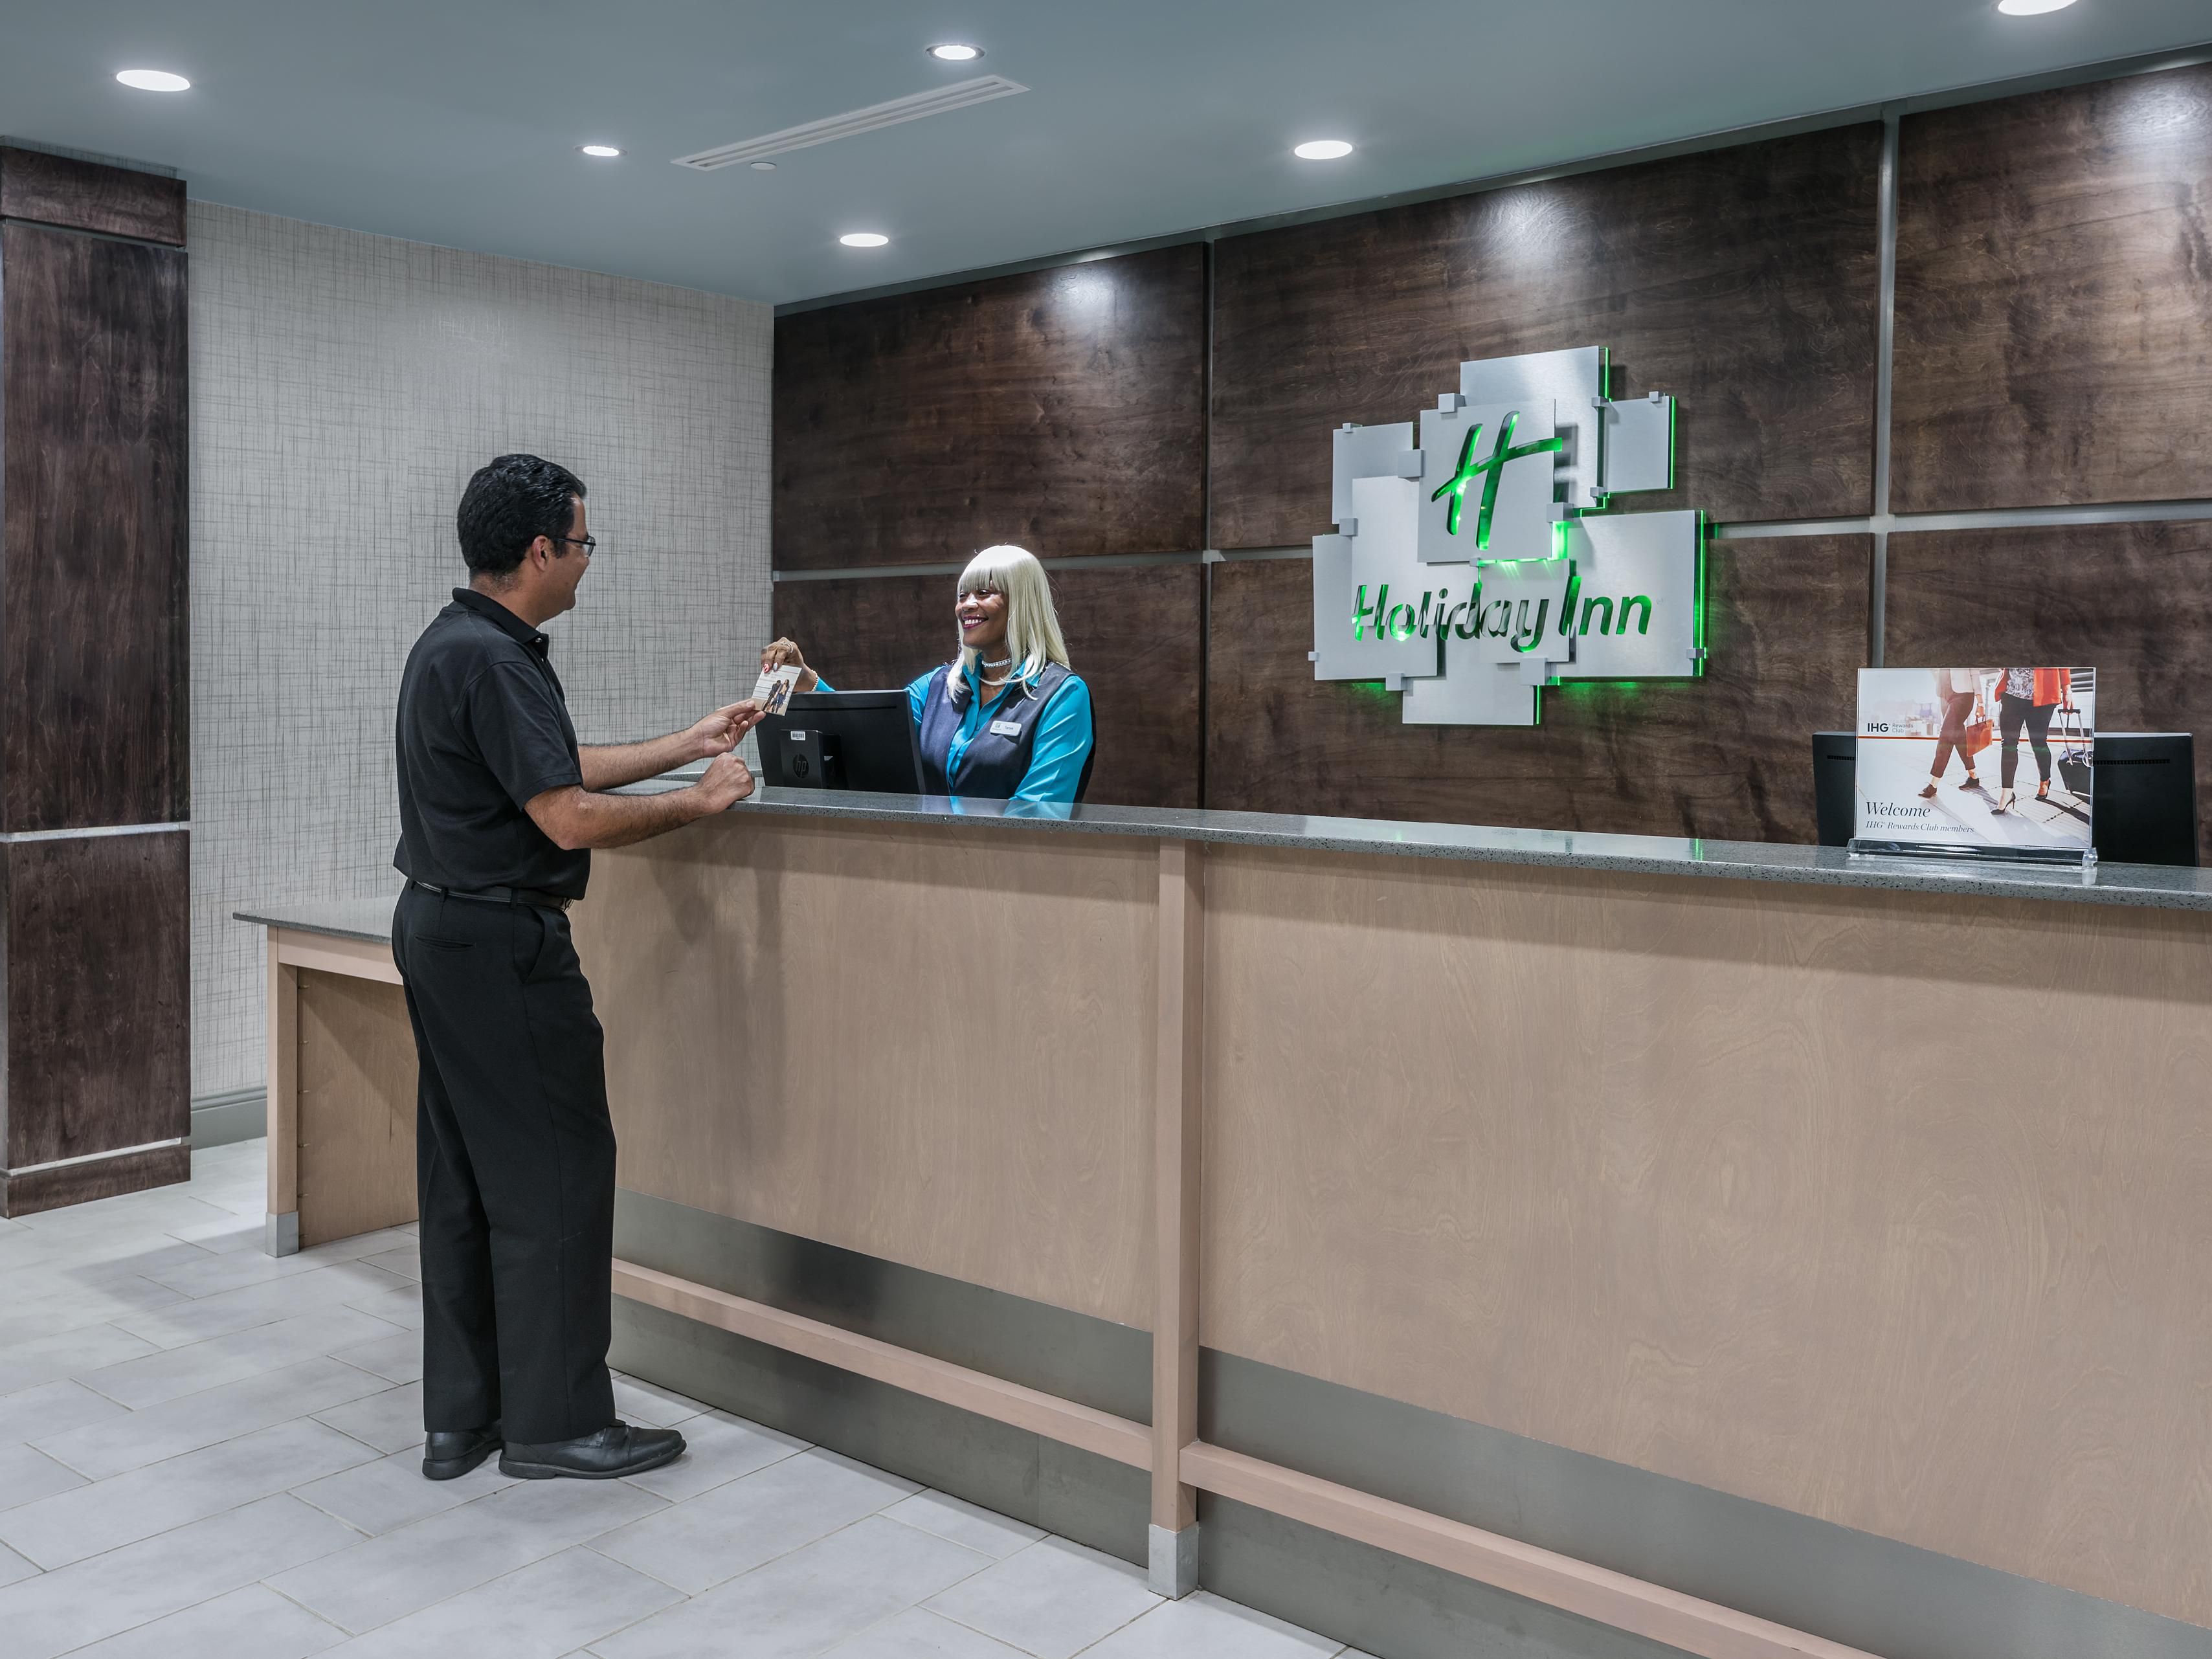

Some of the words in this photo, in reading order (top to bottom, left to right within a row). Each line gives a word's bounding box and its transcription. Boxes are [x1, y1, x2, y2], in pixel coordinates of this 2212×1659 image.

[1431, 410, 1562, 550] H
[1352, 581, 1550, 653] Holiday
[1558, 575, 1653, 637] Inn
[1867, 722, 1889, 733] IHG
[795, 754, 807, 777] hp
[1866, 801, 1931, 818] Welcome
[1887, 821, 1919, 830] Rewards
[1921, 823, 1939, 831] Club
[1939, 824, 1975, 833] members
